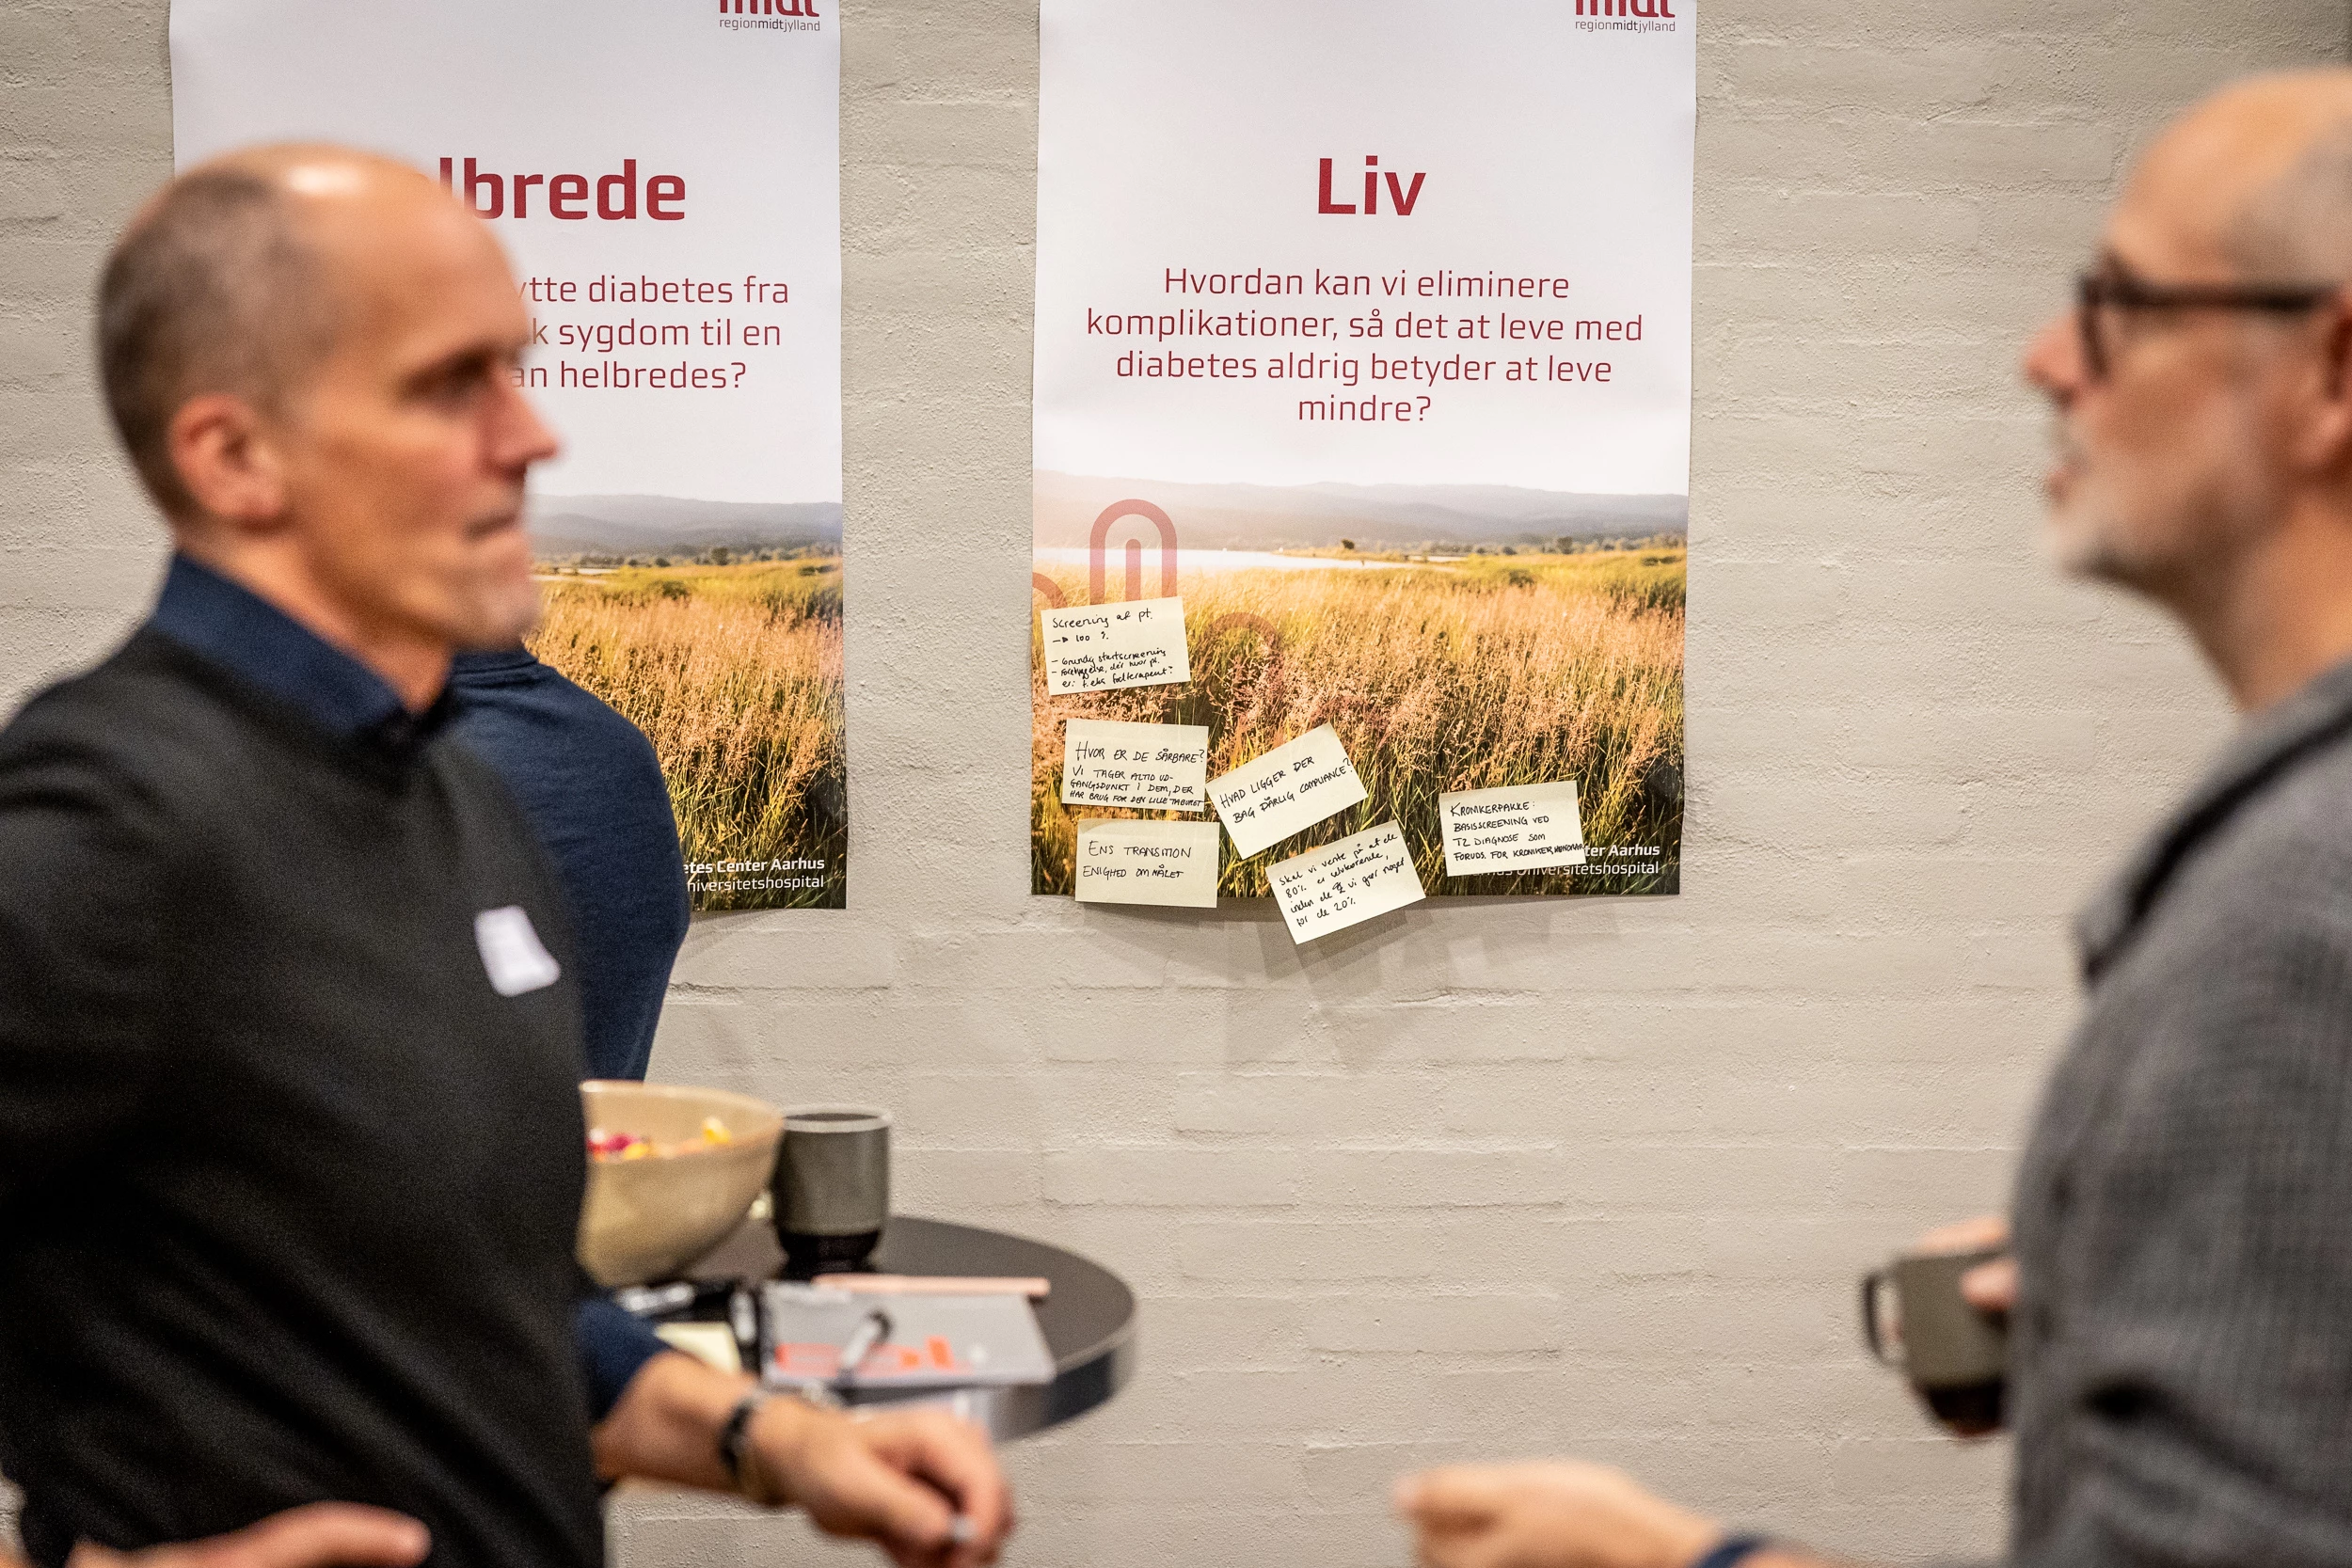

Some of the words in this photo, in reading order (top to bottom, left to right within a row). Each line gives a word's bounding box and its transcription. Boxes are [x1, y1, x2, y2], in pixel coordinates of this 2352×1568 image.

[719, 17, 820, 32] regionmidtjylland
[1575, 19, 1676, 33] regionmidtjylland
[439, 157, 686, 221] lbrede
[1318, 156, 1426, 216] Liv
[588, 275, 733, 304] diabetes
[743, 276, 789, 304] fra
[1165, 267, 1304, 296] Hvordan
[1315, 269, 1372, 296] kan
[1382, 270, 1406, 297] vi
[1417, 270, 1570, 299] eliminere
[1087, 308, 1338, 341] komplikationer,
[1349, 309, 1385, 339] så
[1394, 310, 1448, 340] det
[1457, 313, 1491, 340] at
[1501, 312, 1565, 341] leve
[1575, 313, 1643, 341] med
[559, 318, 689, 353] sygdom
[701, 319, 732, 346] til
[743, 325, 781, 346] en
[510, 367, 548, 388] an
[561, 360, 747, 388] helbredes?
[1117, 351, 1257, 379] diabetes
[1267, 353, 1359, 386] aldrig
[1372, 353, 1497, 387] betyder
[1505, 356, 1539, 382] at
[1549, 355, 1612, 382] leve
[1298, 395, 1432, 422] mindre?
[1053, 614, 1109, 628] Screening
[1117, 611, 1132, 620] af
[1114, 750, 1128, 761] ER
[1133, 752, 1150, 762] DE
[1155, 748, 1205, 763] SÅRBARE?
[1093, 768, 1126, 779] TAGER
[1130, 773, 1155, 782] ALTID
[1218, 788, 1247, 809] HVAD
[1250, 769, 1287, 794] LIGGER
[1293, 756, 1315, 772] DER
[1070, 789, 1085, 799] HAR
[1089, 794, 1109, 802] BRUG
[1172, 785, 1194, 795] DER
[1232, 807, 1256, 824] BAG
[1260, 791, 1295, 812] DÅRLIG
[1454, 816, 1529, 832] BASISSCREENING
[1533, 816, 1549, 824] VED
[1474, 833, 1519, 846] DIAGNOSE
[1528, 833, 1546, 842] SOM
[1123, 847, 1192, 858] TRANSITION
[1490, 851, 1509, 860] FOR
[1609, 843, 1661, 857] Aarhus
[717, 860, 767, 873] Center
[771, 857, 825, 872] Aarhus
[1083, 865, 1127, 880] ENIGHED
[1136, 868, 1150, 877] OM
[1152, 863, 1184, 879] MÅLET
[1279, 871, 1303, 886] Skal
[1309, 864, 1317, 874] vi
[1321, 852, 1347, 867] vente
[688, 875, 824, 893] niversitetshospital
[1347, 878, 1358, 888] vi
